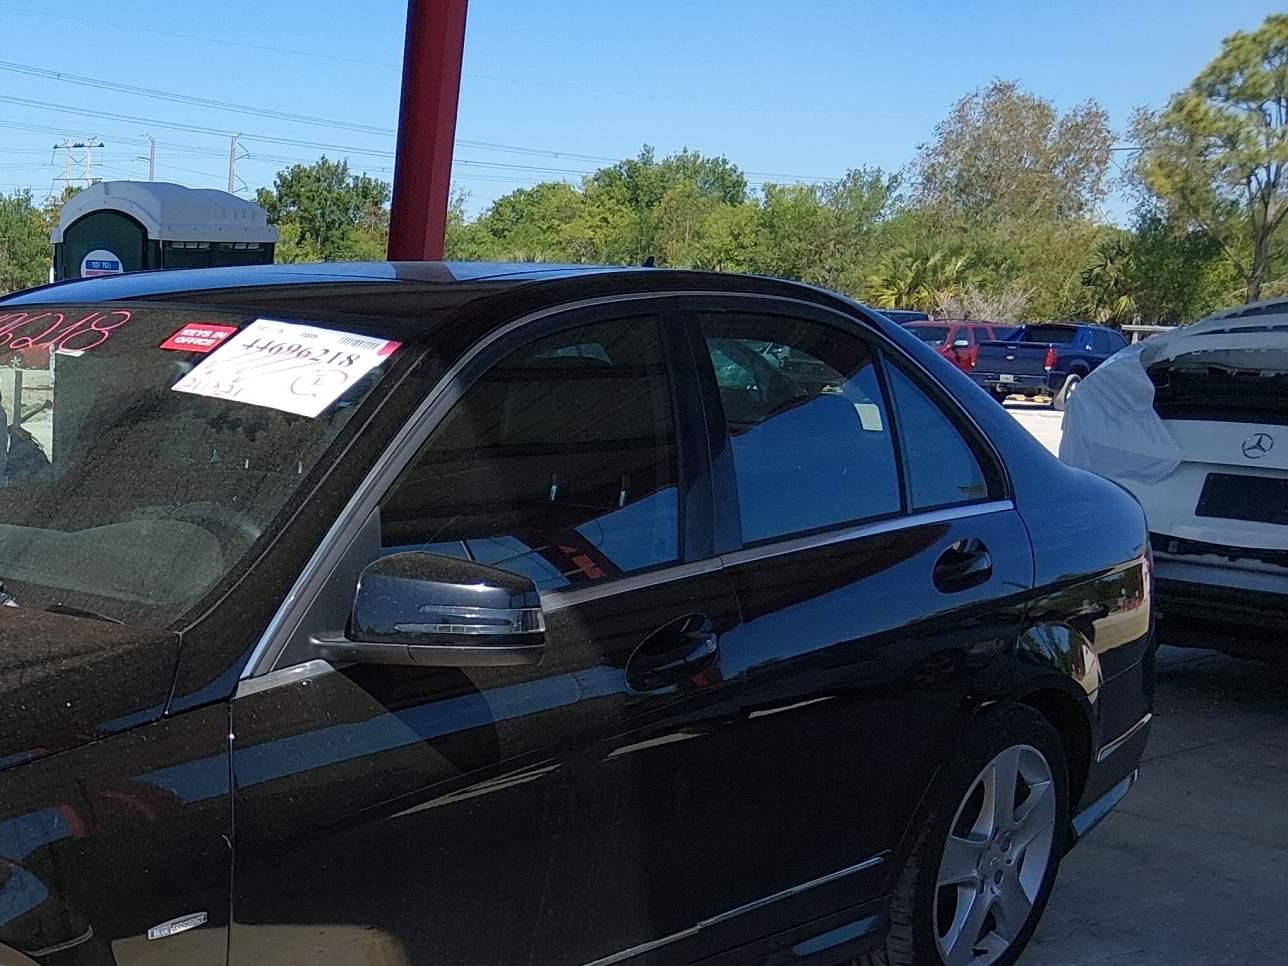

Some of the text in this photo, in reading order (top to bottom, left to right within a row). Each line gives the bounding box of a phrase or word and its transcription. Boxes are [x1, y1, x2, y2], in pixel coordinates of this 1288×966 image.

[180, 328, 229, 339] KEYS IN
[174, 336, 216, 347] OFFICE
[242, 338, 361, 367] 44696218
